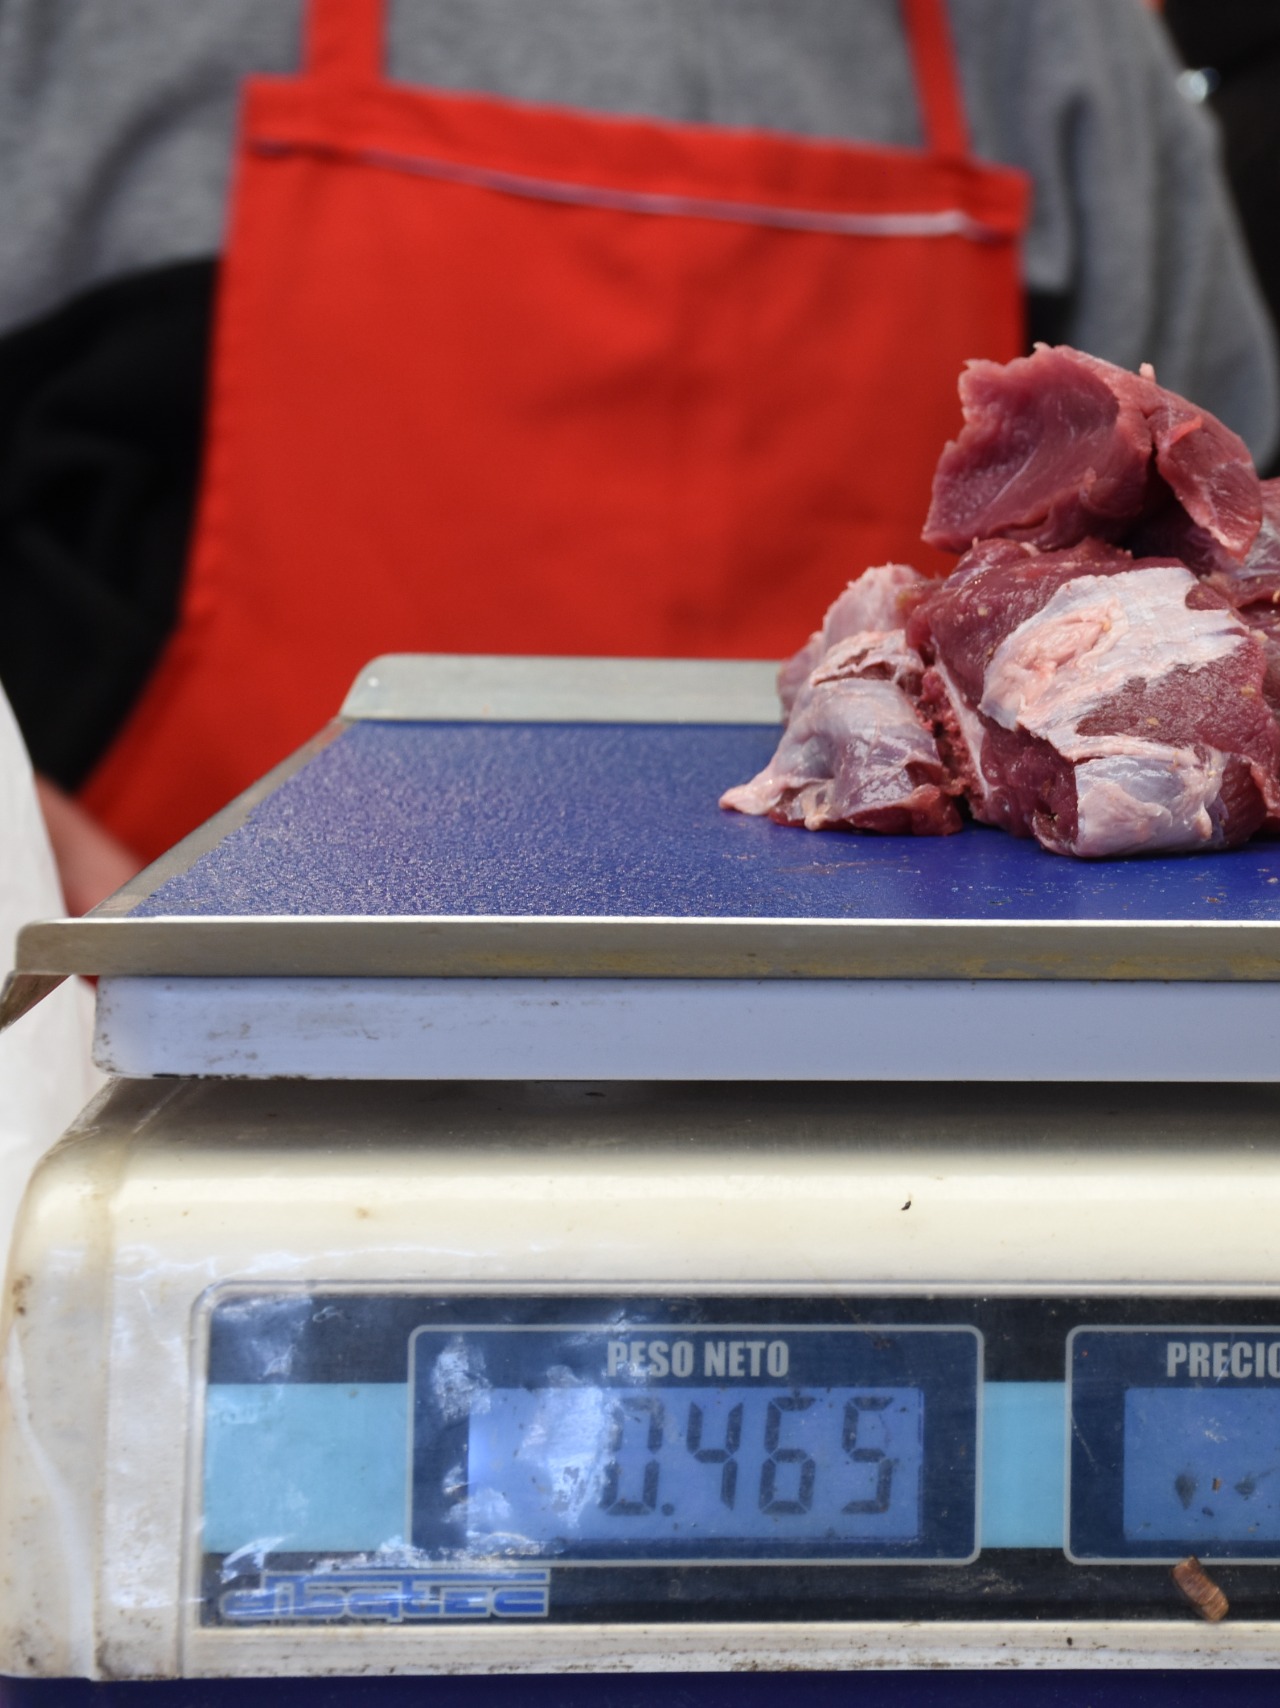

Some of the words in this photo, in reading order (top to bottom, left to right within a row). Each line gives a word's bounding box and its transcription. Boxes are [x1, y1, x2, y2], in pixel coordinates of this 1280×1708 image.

[608, 1341, 694, 1378] PESO
[704, 1342, 789, 1378] NETO
[602, 1397, 895, 1516] 0.465
